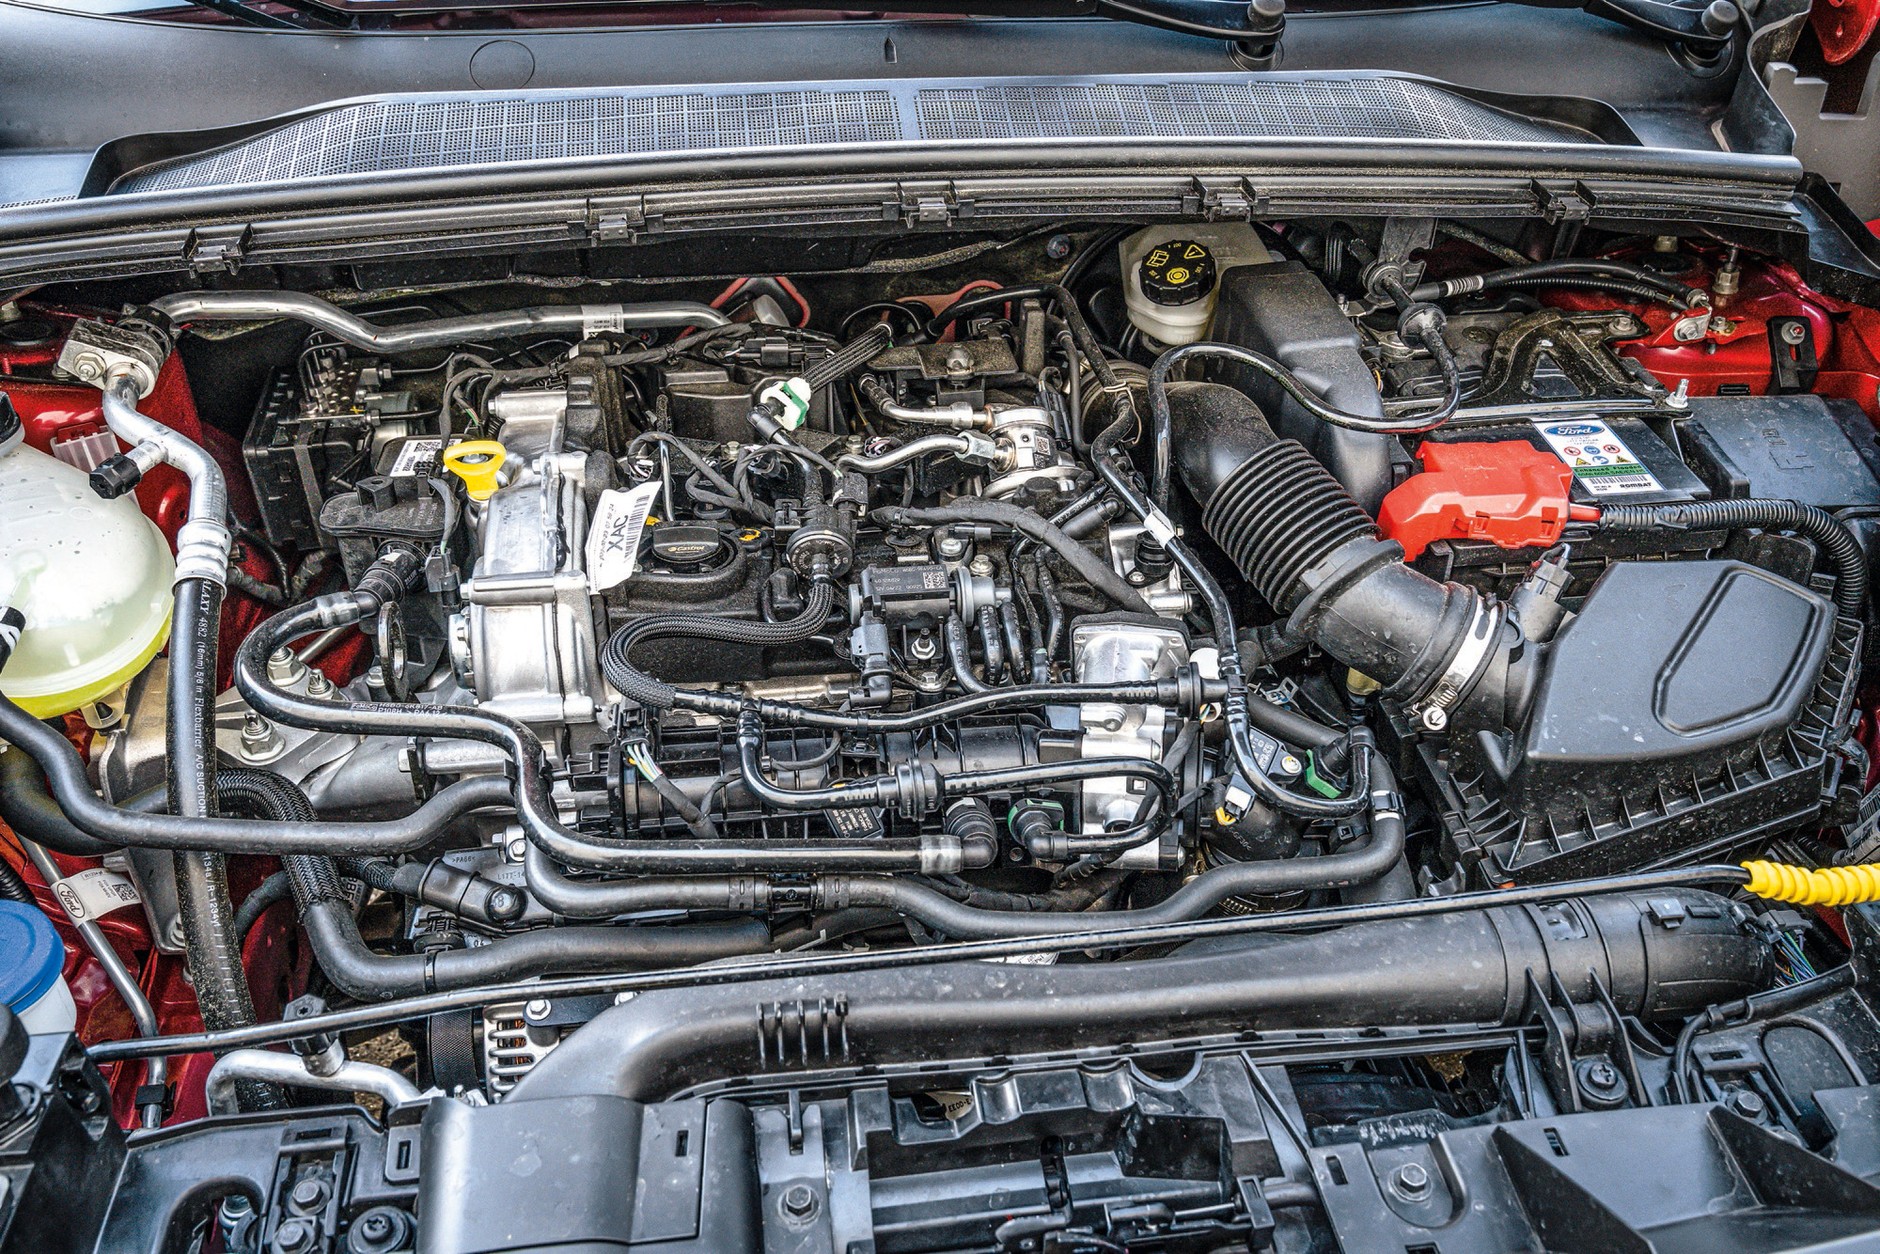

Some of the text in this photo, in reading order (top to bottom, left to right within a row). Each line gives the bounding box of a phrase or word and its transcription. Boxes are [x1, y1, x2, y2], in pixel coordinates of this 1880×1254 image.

[1557, 426, 1593, 435] Ford
[606, 514, 629, 553] XAC
[197, 617, 208, 637] 4882
[195, 641, 206, 669] (16mm)
[194, 697, 205, 748] Flexbarrier
[194, 754, 204, 769] A/C
[196, 771, 207, 813] SUCTION
[452, 856, 476, 864] >PA66<
[60, 889, 81, 913] Ford
